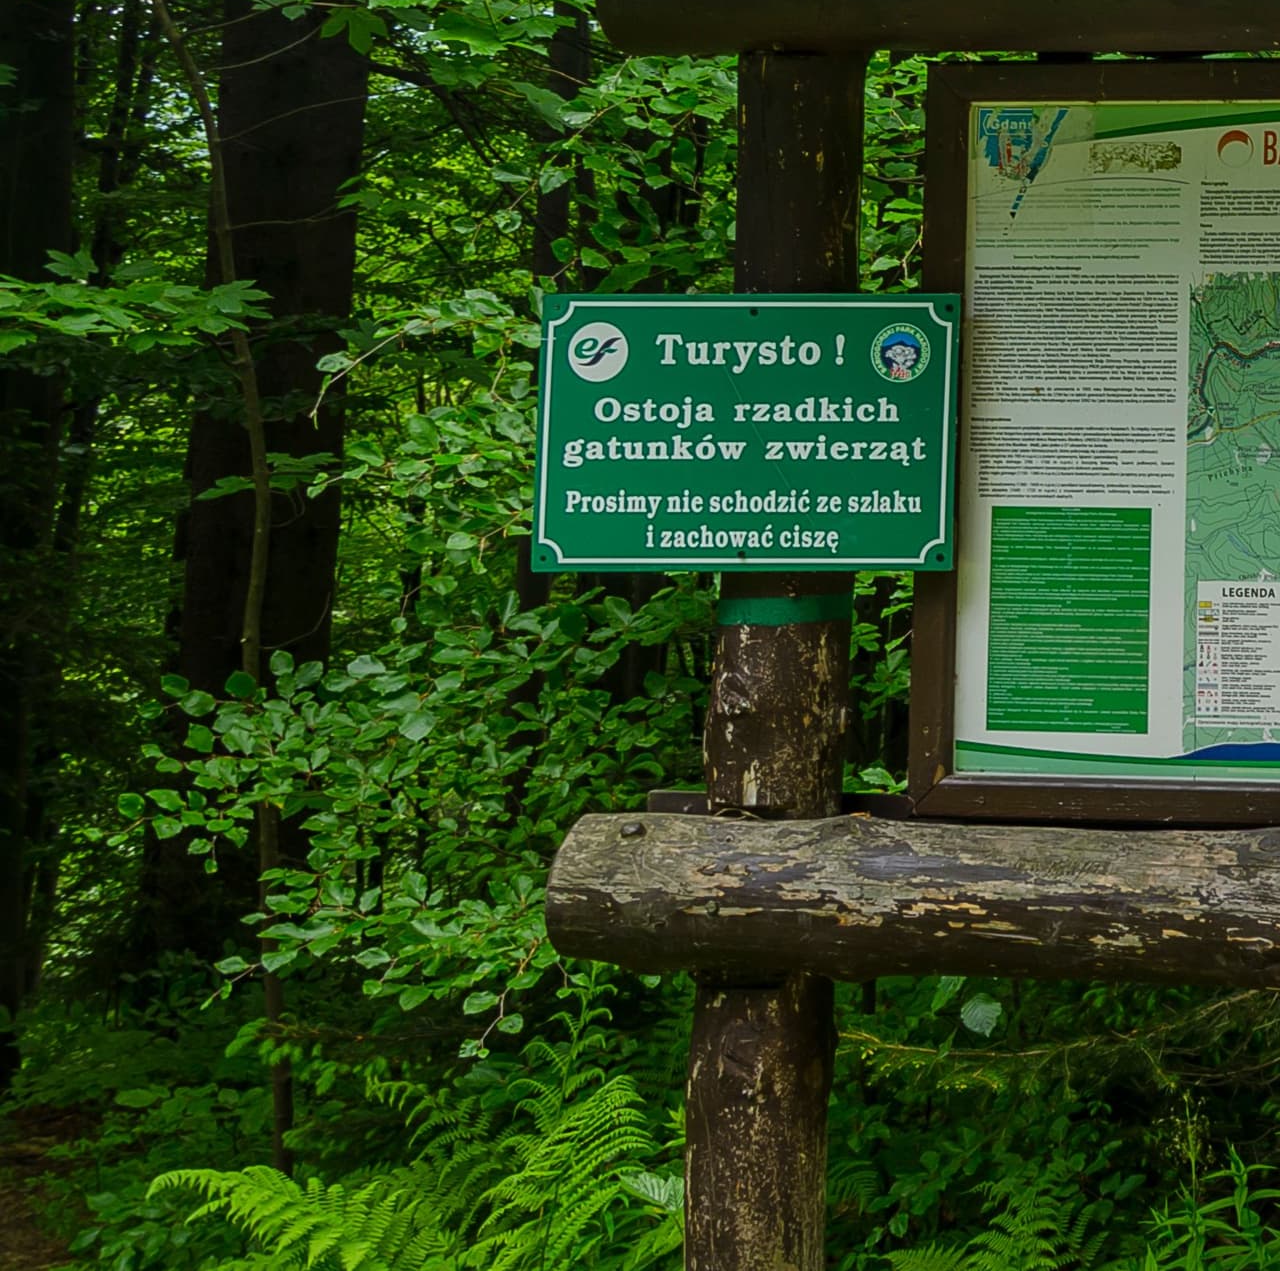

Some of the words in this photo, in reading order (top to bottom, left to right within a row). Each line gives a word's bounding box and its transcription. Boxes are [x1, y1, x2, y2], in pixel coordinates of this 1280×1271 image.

[655, 333, 822, 374] Turysto
[834, 333, 847, 366] !
[594, 396, 715, 429] Ostoja
[733, 396, 900, 424] rzadkich
[562, 434, 747, 468] gatunków
[764, 434, 927, 467] zwierząt
[565, 489, 662, 520] Prosimy
[666, 490, 704, 514] nie
[709, 488, 810, 515] schodzić
[816, 496, 842, 514] ze
[847, 489, 922, 514] szlaku
[645, 524, 655, 548] i
[660, 523, 774, 549] zachować
[778, 524, 840, 554] ciszę
[1221, 587, 1276, 598] LEGENDA
